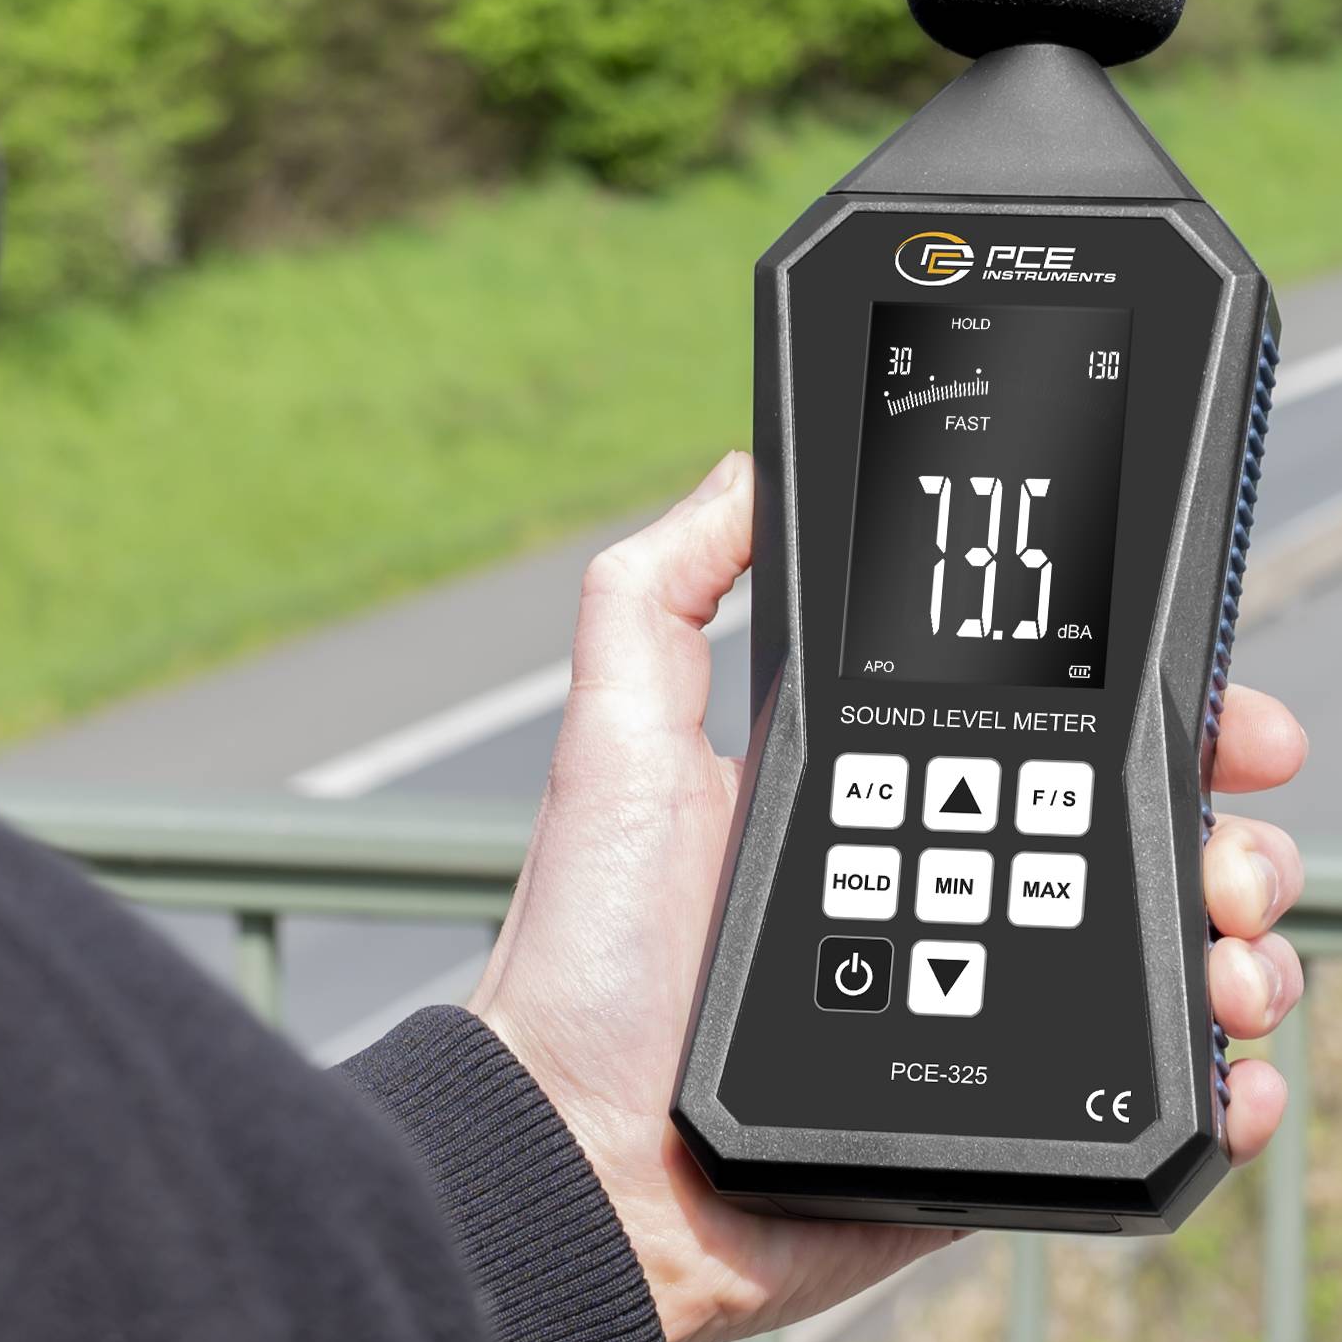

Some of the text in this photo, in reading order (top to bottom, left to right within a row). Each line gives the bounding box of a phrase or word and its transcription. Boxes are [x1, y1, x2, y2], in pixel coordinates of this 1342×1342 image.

[985, 245, 1077, 270] PCE
[982, 269, 1117, 283] INSTRUMENTS
[951, 317, 991, 331] HOLD
[887, 346, 913, 376] 30
[1088, 350, 1120, 380] 130
[945, 415, 991, 432] FAST
[919, 475, 1053, 641] 73.5
[1057, 624, 1093, 640] dBA
[863, 660, 895, 673] APO
[840, 705, 1097, 733] SOUND LEVEL METER
[832, 873, 891, 892] HOLD
[935, 877, 974, 895] MIN
[1022, 880, 1071, 900] MAX
[890, 1061, 988, 1085] PCE-325
